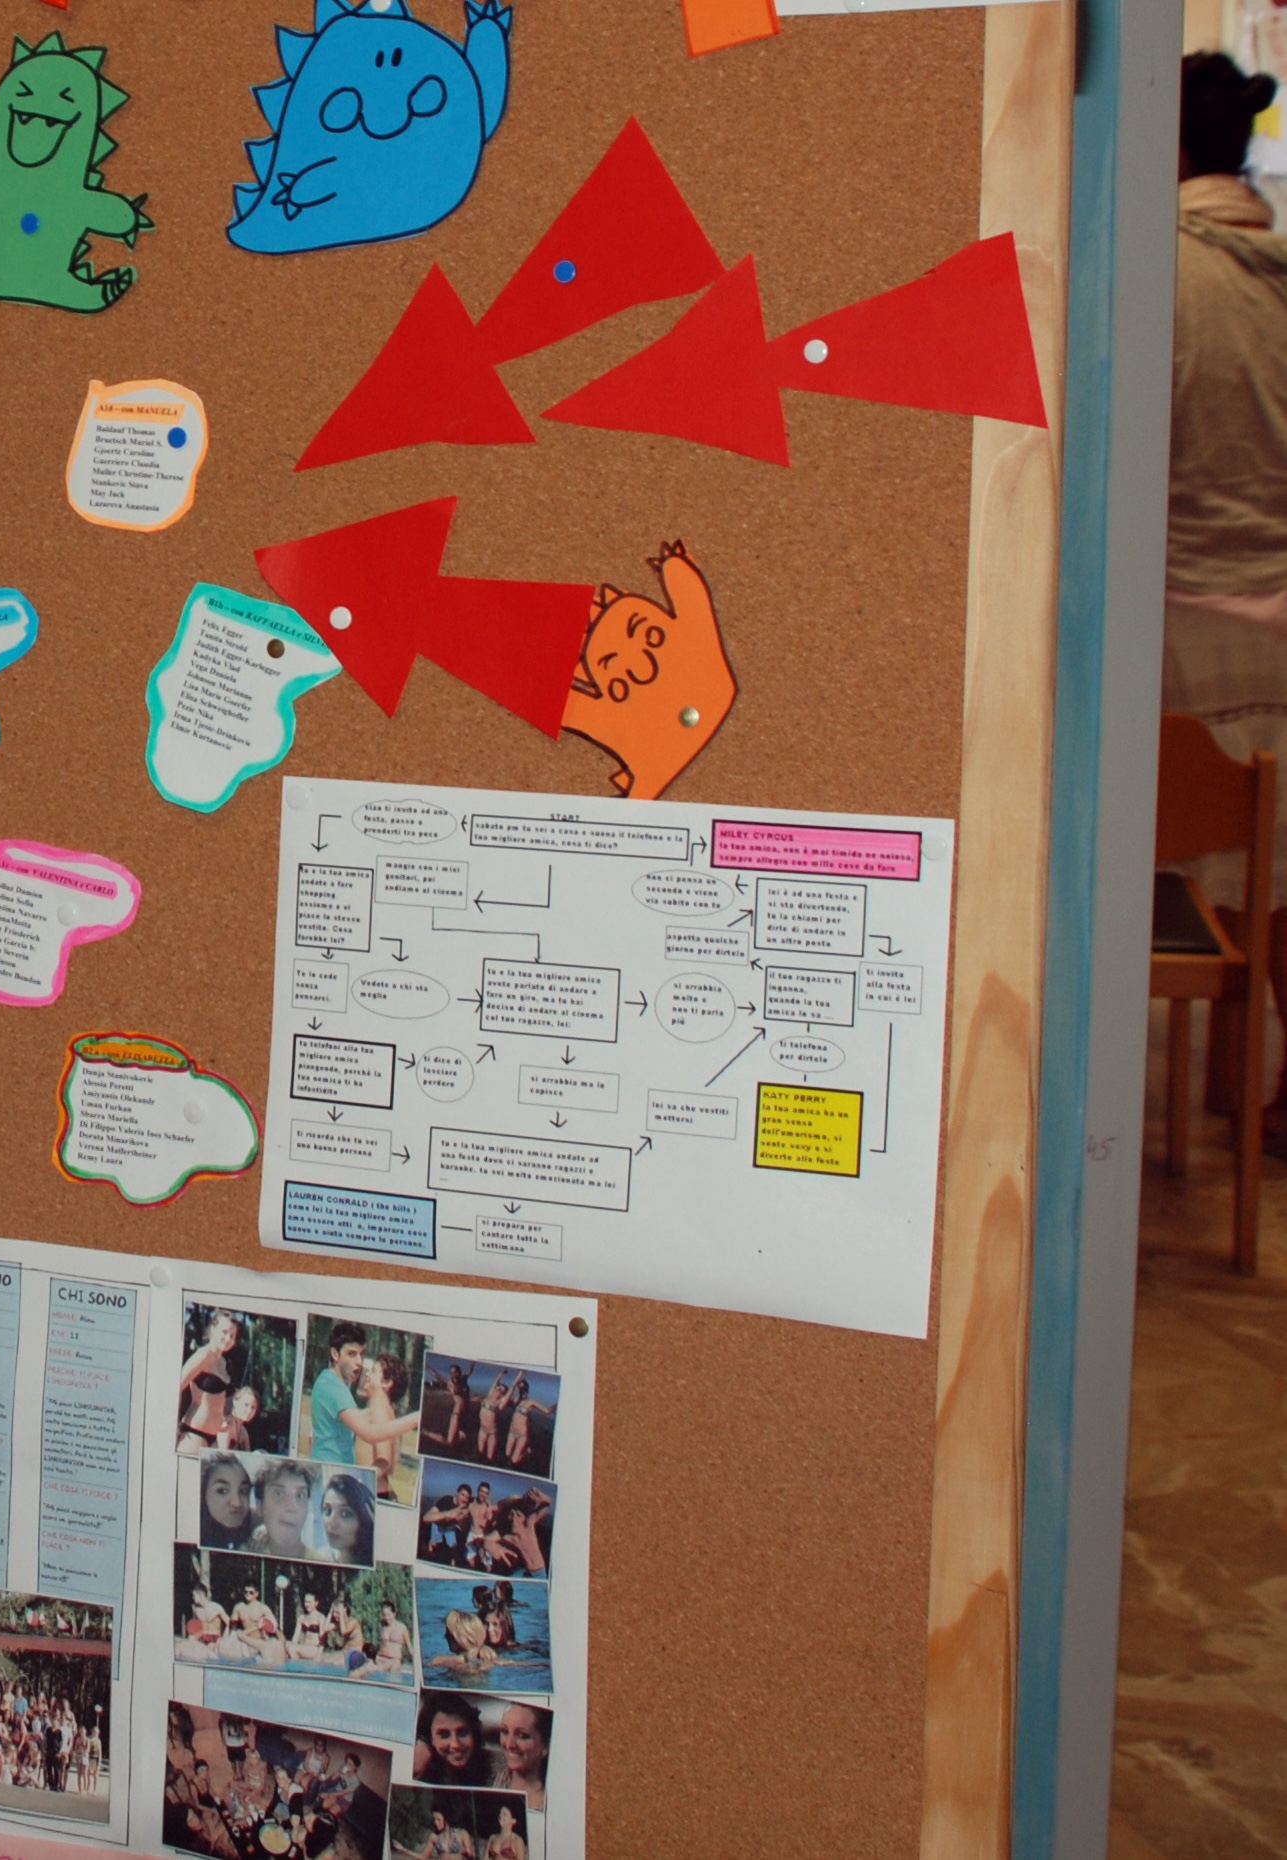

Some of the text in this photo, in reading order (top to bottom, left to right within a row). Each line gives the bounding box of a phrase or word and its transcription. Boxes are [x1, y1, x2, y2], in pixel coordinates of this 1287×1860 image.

[303, 633, 327, 647] SILV
[549, 813, 580, 821] START
[475, 822, 504, 830] sabato
[627, 832, 663, 841] telefono
[720, 830, 748, 839] MILEY
[474, 833, 488, 841] tua
[491, 835, 526, 843] migliore
[529, 838, 558, 846] amica,
[719, 841, 728, 849] la
[730, 843, 747, 851] tua
[748, 845, 780, 853] amica,
[831, 849, 863, 858] timida
[719, 854, 753, 863] sempre
[756, 856, 789, 866] allegra
[810, 860, 835, 868] mille
[837, 862, 860, 870] cose
[863, 863, 875, 871] da
[877, 863, 896, 872] fare
[825, 892, 849, 901] festa
[797, 902, 850, 913] divertendo,
[767, 912, 776, 920] tu
[791, 914, 823, 922] chiami
[767, 924, 787, 932] dirle
[763, 1091, 826, 1103] KATY PERRY
[774, 1105, 789, 1113] tua
[792, 1108, 821, 1116] amica
[824, 1109, 835, 1117] ha
[786, 1119, 813, 1127] senso
[760, 1141, 786, 1149] sente
[790, 1144, 811, 1152] sexy
[760, 1151, 792, 1161] diverte
[816, 1156, 840, 1166] feste
[288, 1191, 324, 1202] LAUREN
[376, 1203, 390, 1211] the
[57, 1286, 128, 1309] CHI SONO
